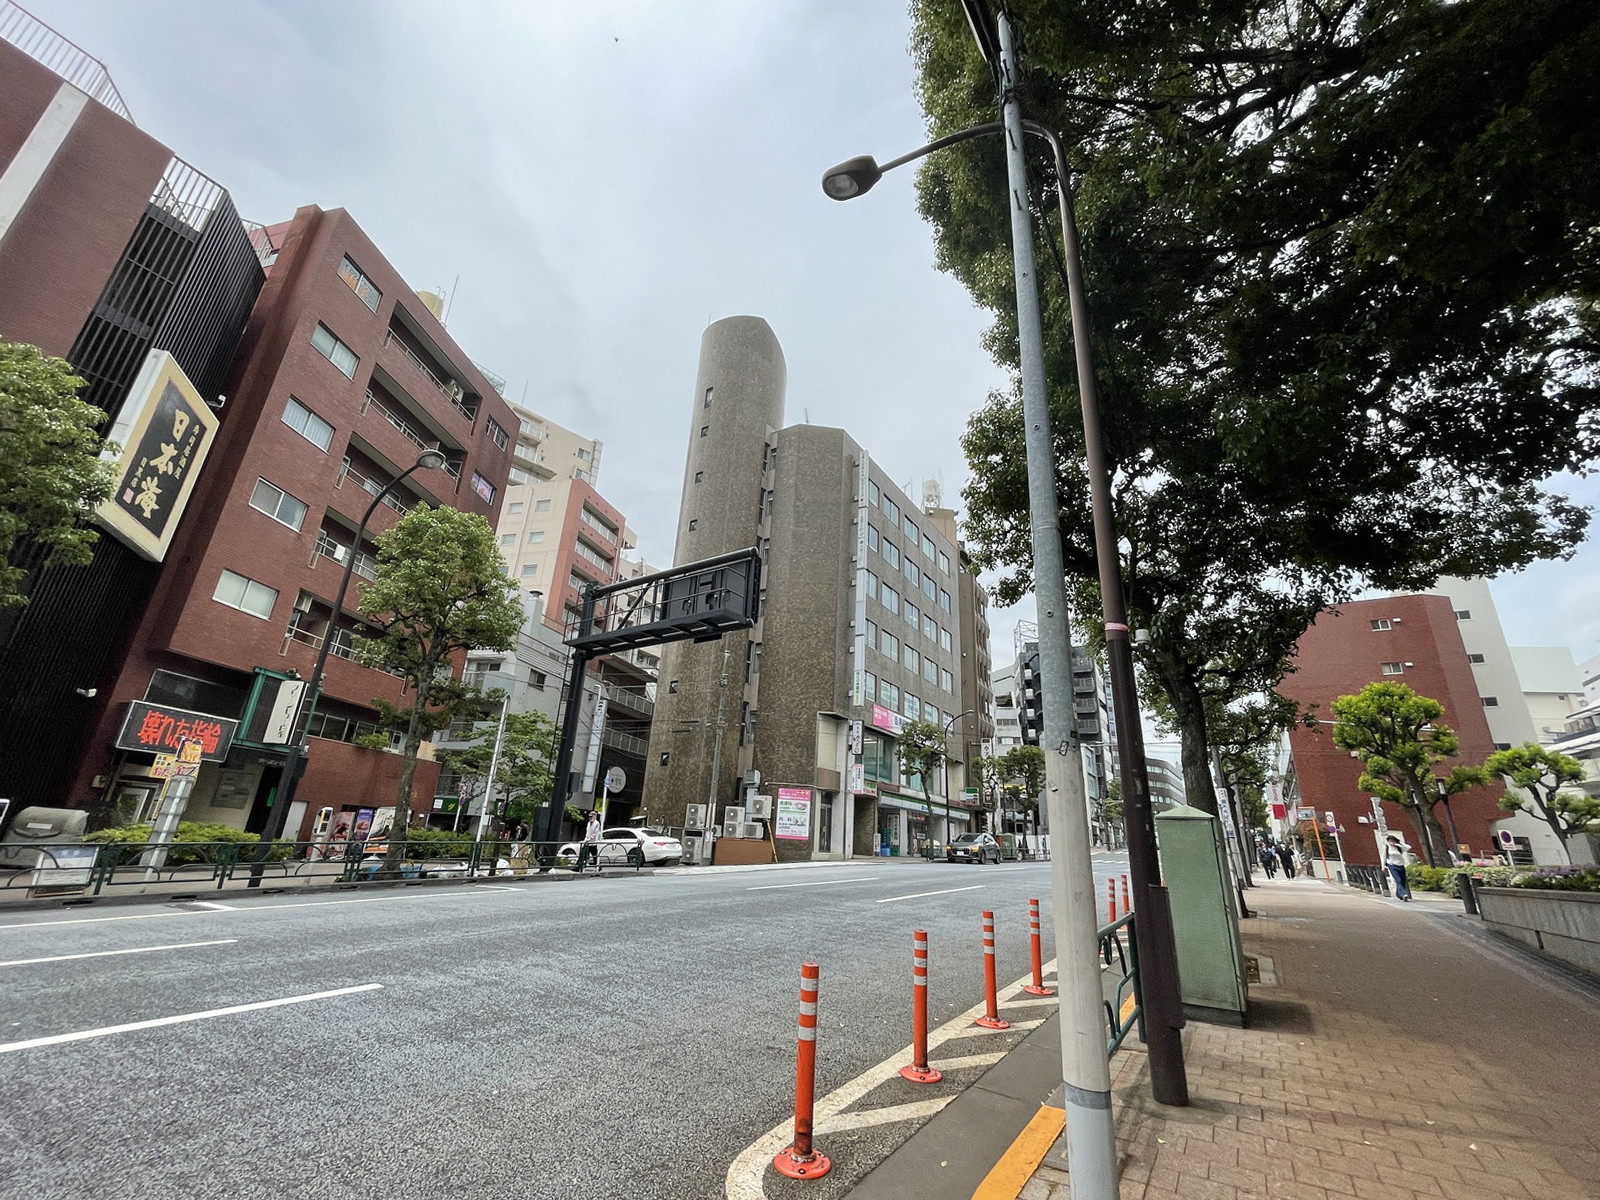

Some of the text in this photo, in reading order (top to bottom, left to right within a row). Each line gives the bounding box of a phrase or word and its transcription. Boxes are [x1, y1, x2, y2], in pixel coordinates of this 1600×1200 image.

[137, 710, 221, 753] 壊れた指輪
